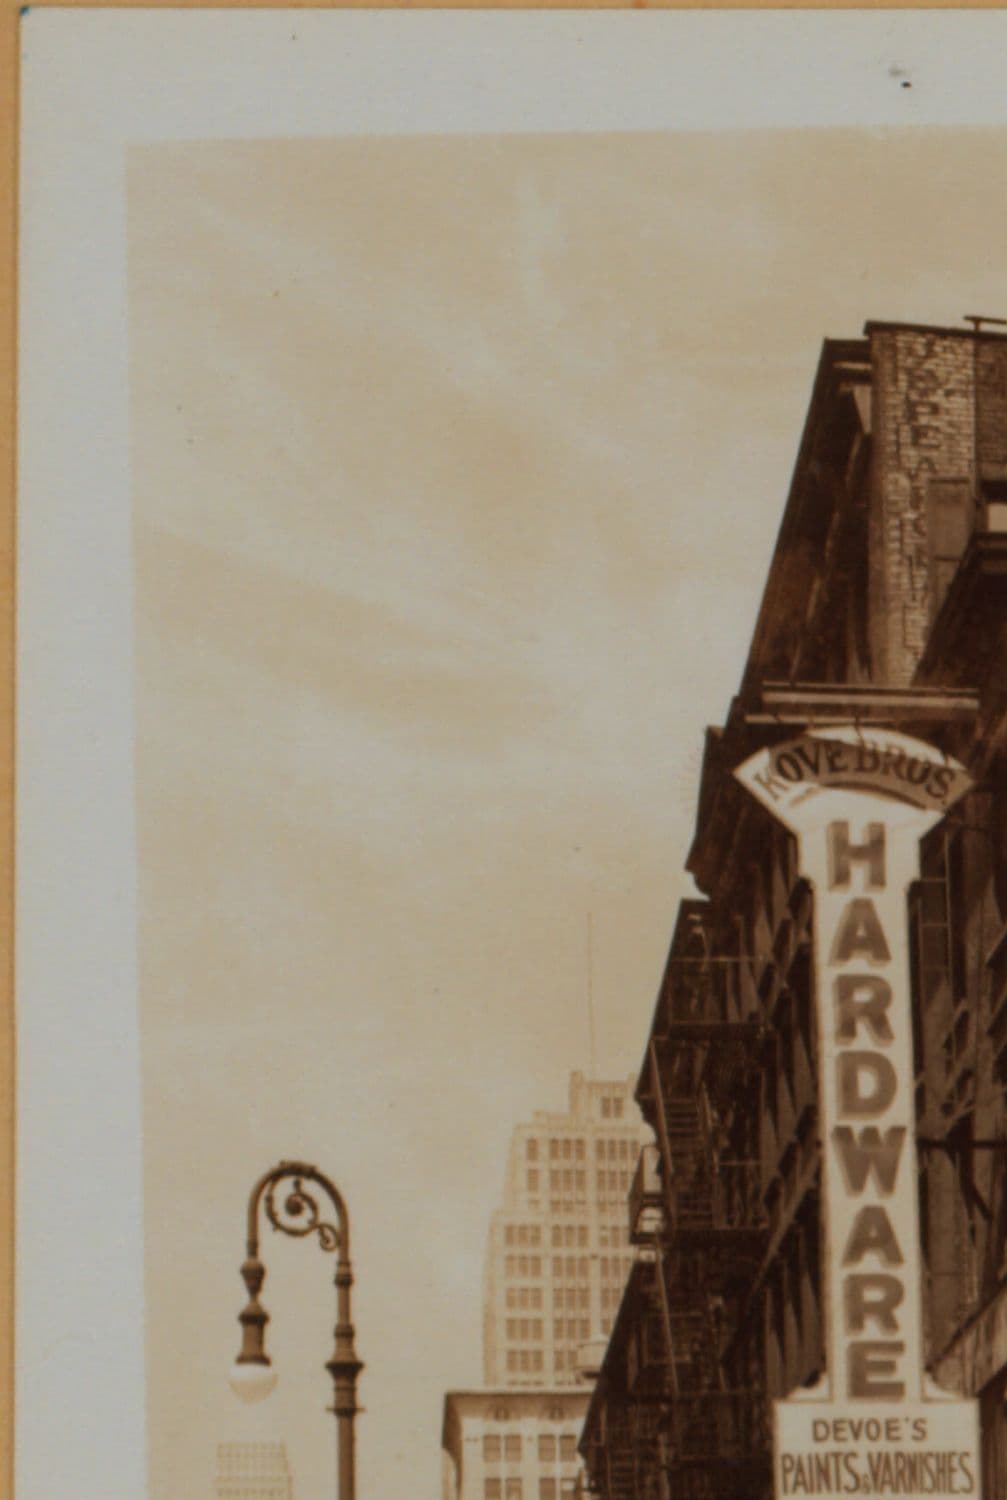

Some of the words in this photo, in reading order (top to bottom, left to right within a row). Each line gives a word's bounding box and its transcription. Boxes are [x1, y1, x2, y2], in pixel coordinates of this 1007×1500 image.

[754, 742, 848, 800] KOVE
[827, 820, 907, 1400] HARDWARE
[812, 1417, 928, 1443] DEVOE'S
[782, 1452, 861, 1496] PAINTS
[868, 1450, 975, 1496] VARNISHES
